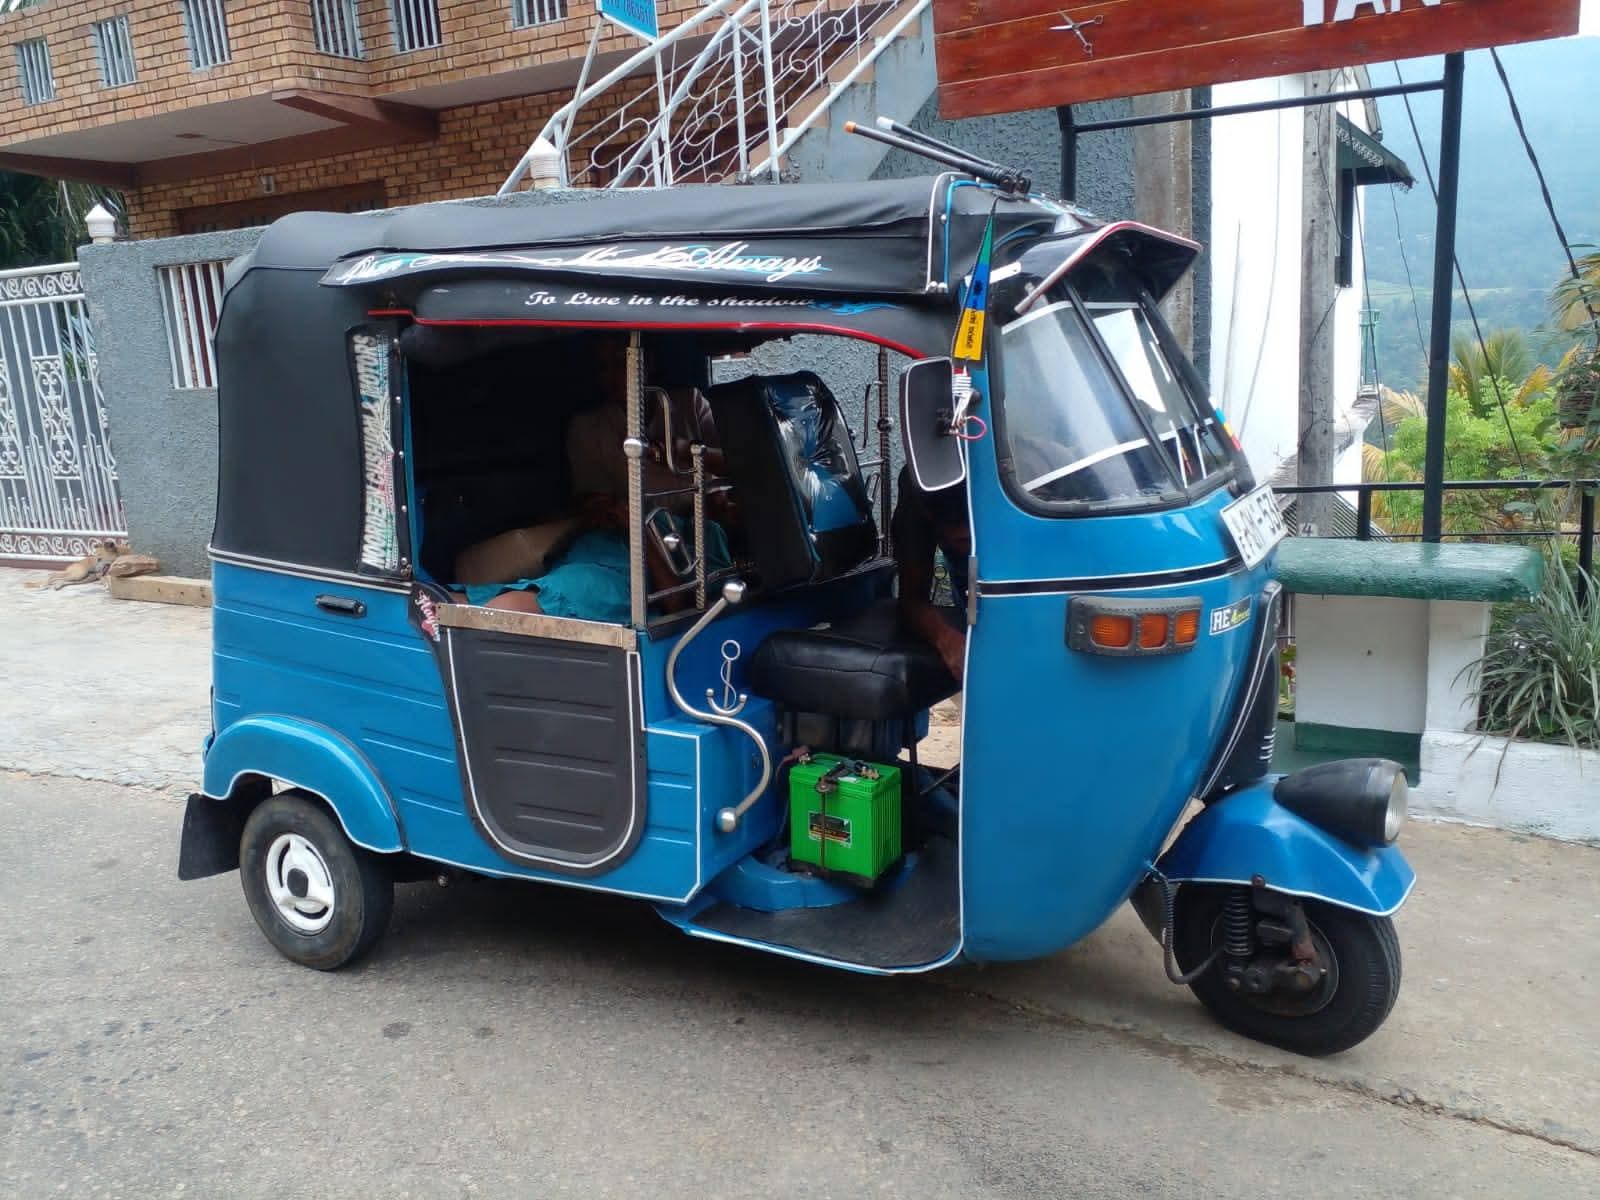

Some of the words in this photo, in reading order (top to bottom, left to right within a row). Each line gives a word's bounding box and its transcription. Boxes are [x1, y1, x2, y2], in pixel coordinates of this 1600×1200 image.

[689, 241, 821, 282] Always
[525, 291, 557, 306] To
[565, 292, 620, 306] Live
[628, 294, 653, 306] in
[660, 295, 699, 306] the
[353, 334, 382, 398] MOTORS
[1212, 608, 1231, 631] RE
